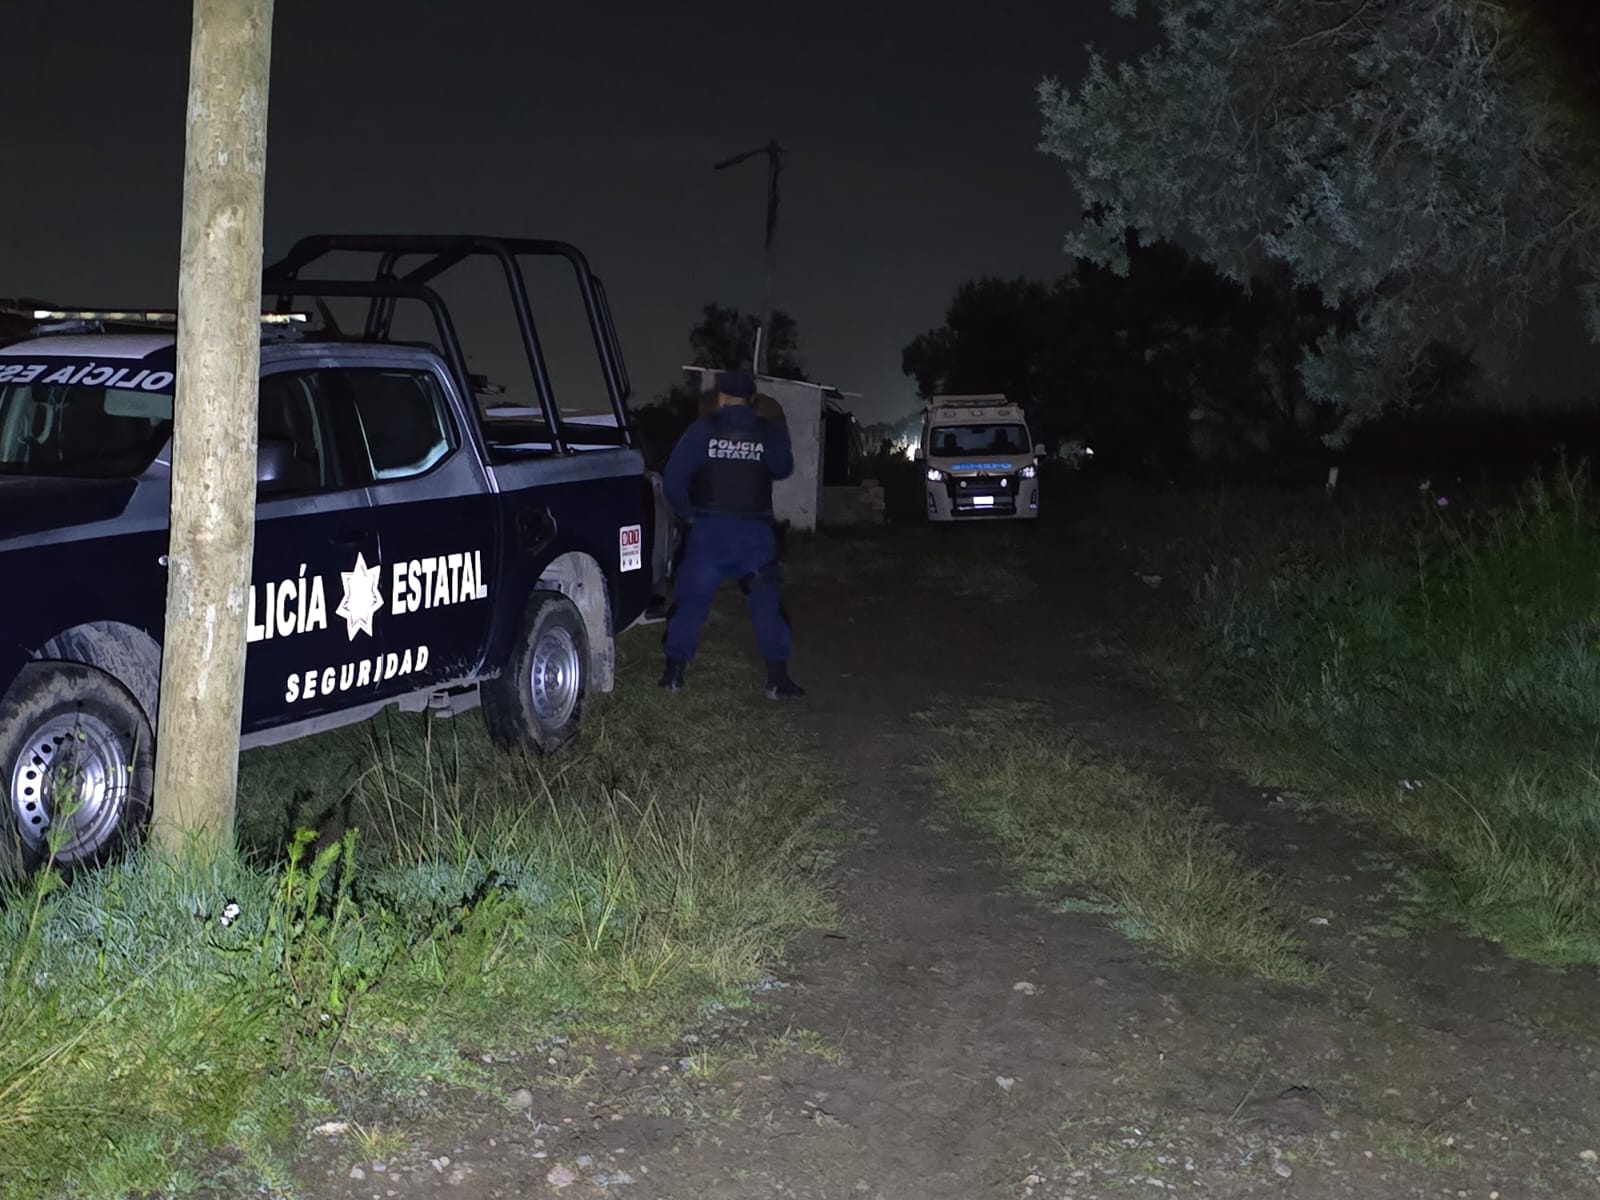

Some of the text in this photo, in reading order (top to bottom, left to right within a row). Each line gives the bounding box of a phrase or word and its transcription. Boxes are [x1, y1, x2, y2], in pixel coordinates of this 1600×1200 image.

[246, 550, 488, 643] LICÍA ESTATAL
[285, 645, 430, 703] SEGURIDAD
